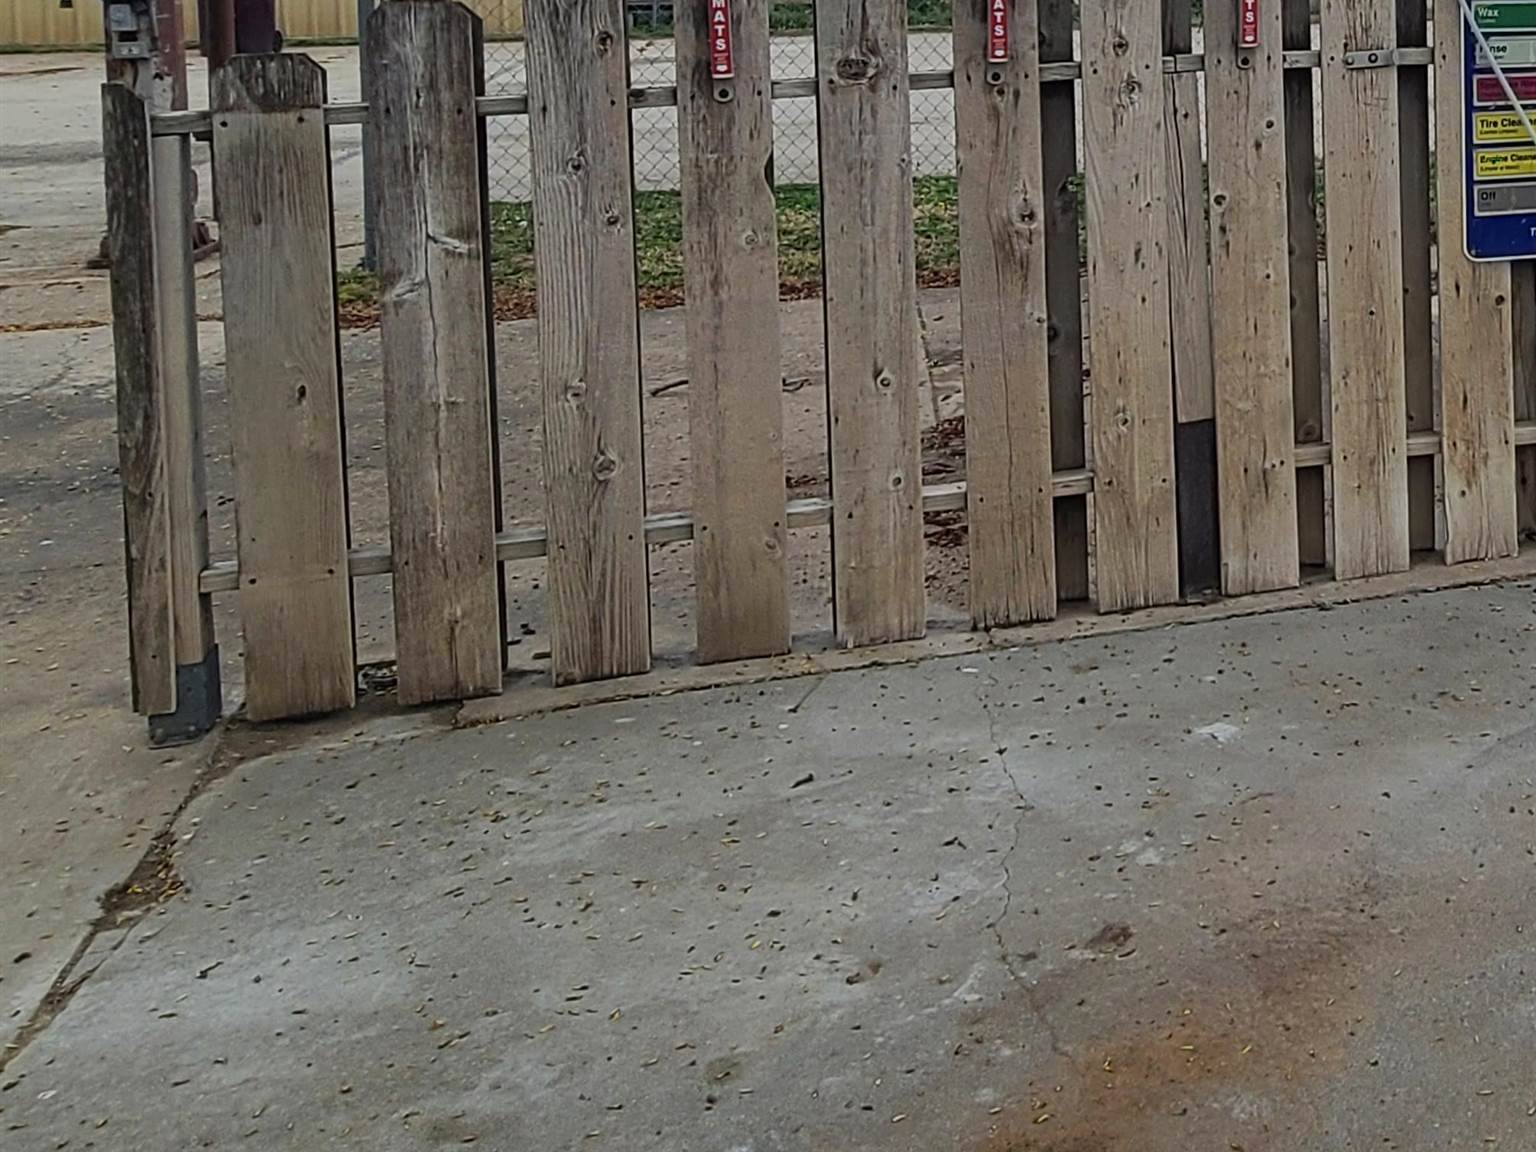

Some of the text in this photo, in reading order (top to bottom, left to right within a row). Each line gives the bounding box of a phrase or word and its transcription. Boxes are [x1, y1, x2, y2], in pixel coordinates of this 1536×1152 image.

[1477, 7, 1499, 17] Wax
[1480, 43, 1507, 53] nse
[1480, 119, 1498, 128] Tire
[1480, 155, 1508, 164] Engine
[1481, 192, 1496, 201] Off
